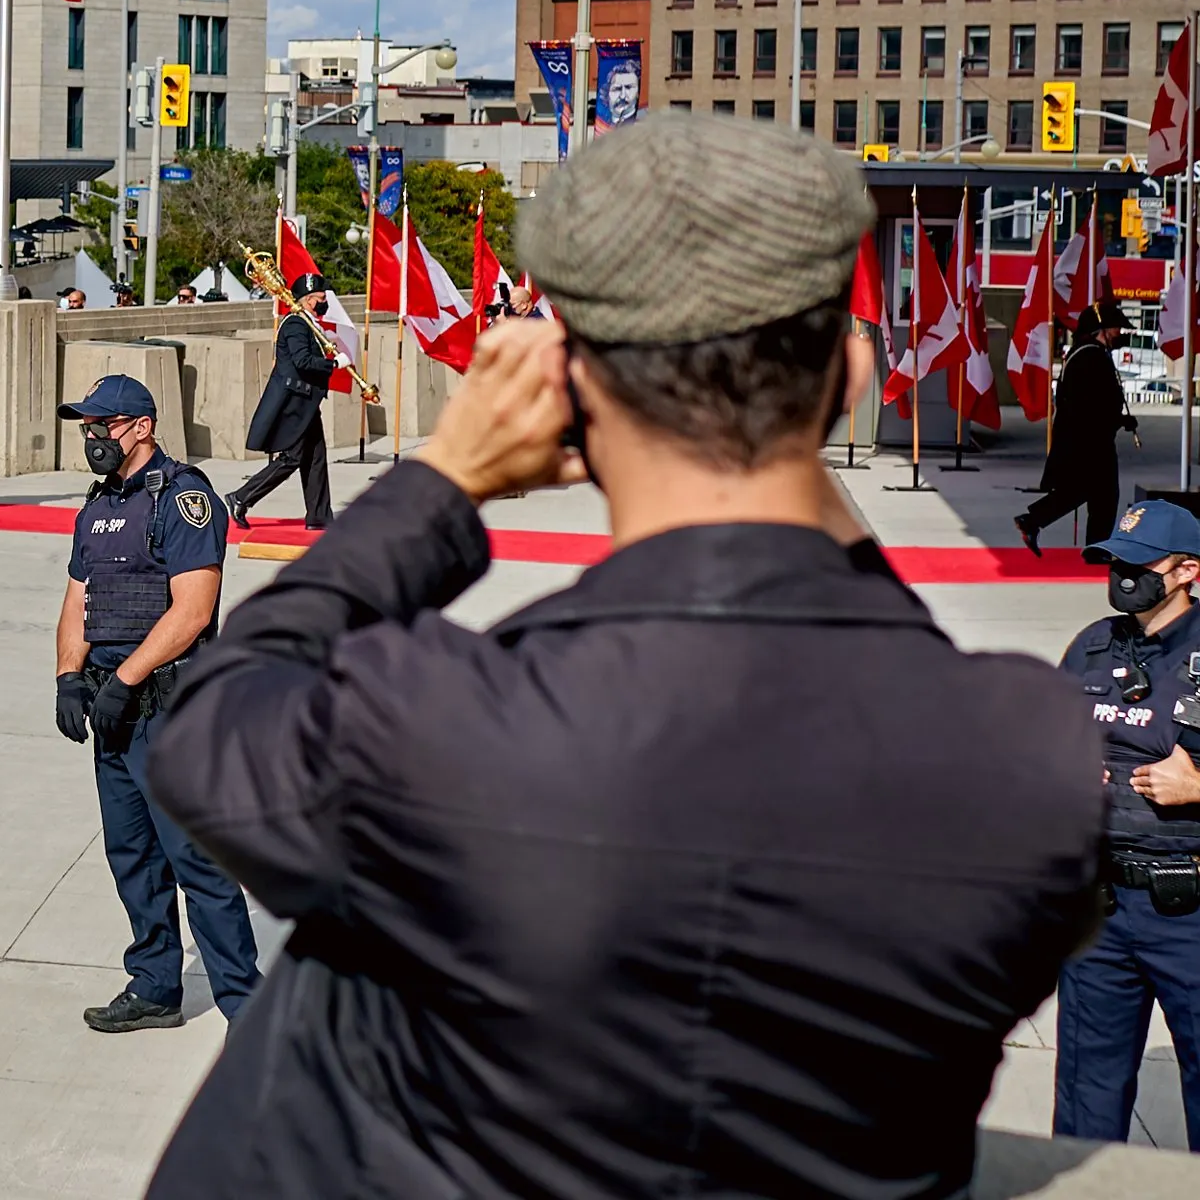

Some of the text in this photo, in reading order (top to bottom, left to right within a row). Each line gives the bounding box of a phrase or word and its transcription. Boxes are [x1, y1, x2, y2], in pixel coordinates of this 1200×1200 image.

[1113, 287, 1160, 298] nking Centre
[90, 518, 127, 535] PPS-SPP
[1093, 703, 1154, 728] PPS-SPP
